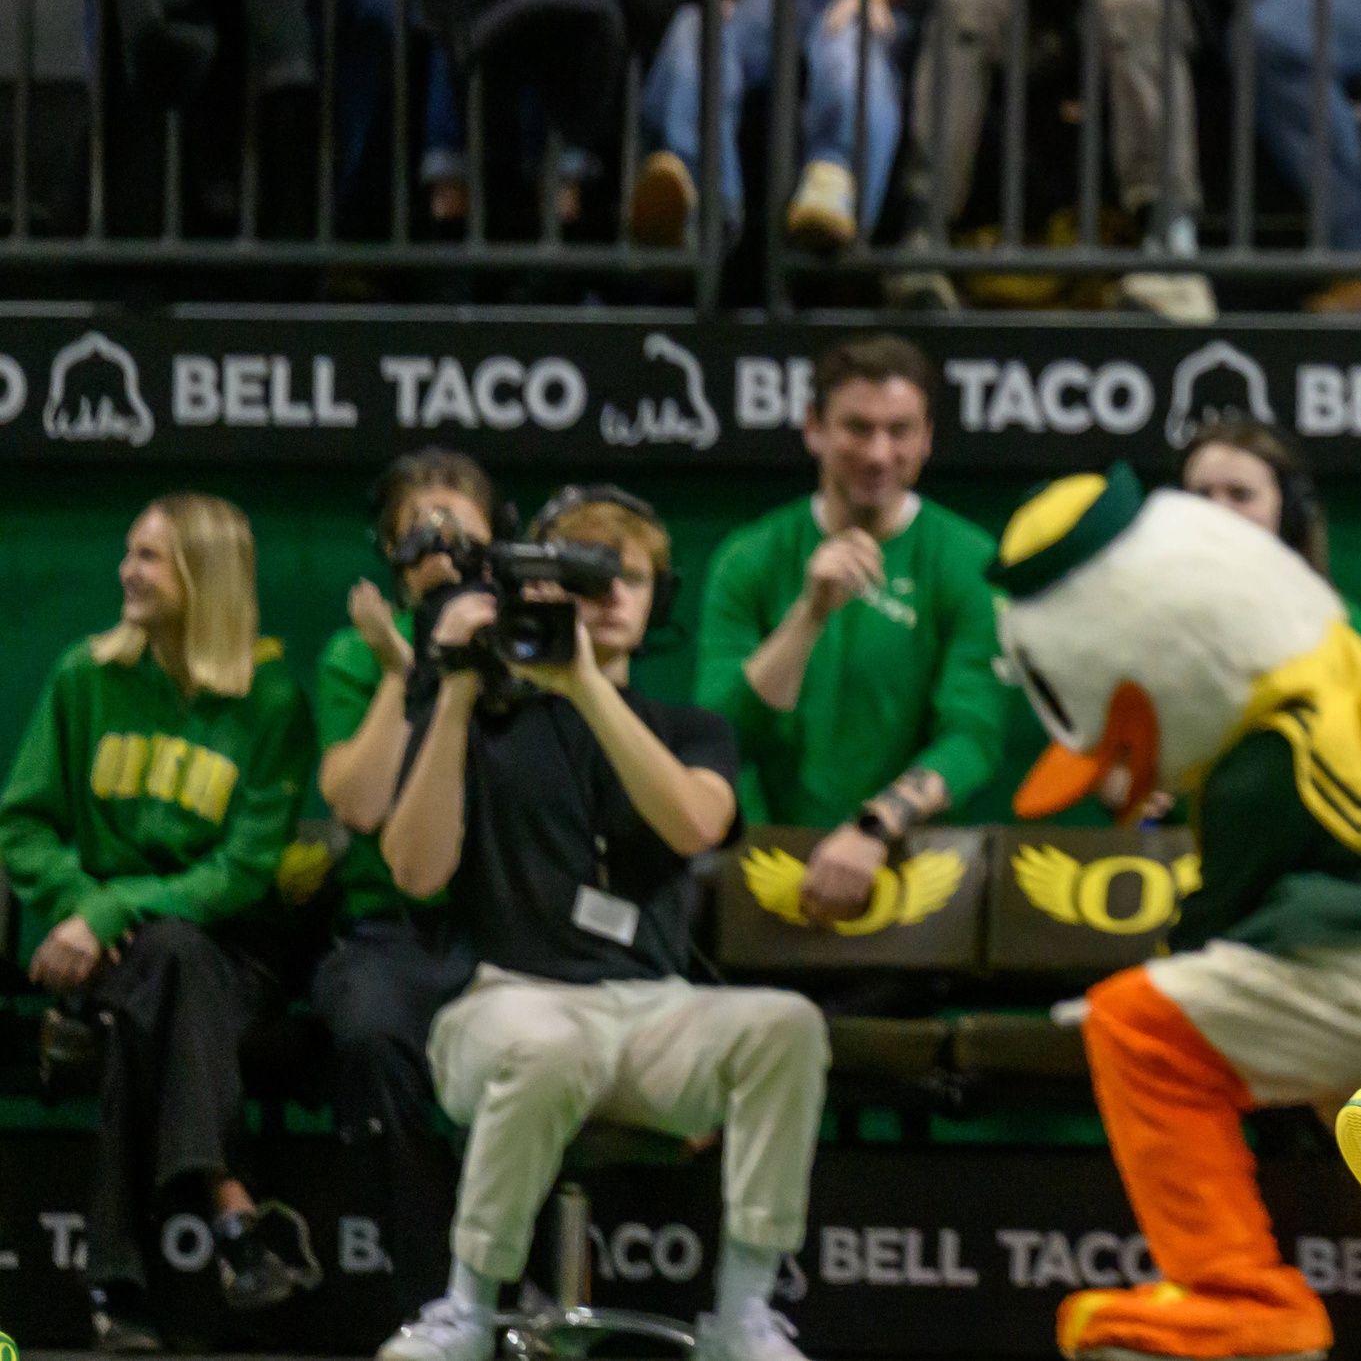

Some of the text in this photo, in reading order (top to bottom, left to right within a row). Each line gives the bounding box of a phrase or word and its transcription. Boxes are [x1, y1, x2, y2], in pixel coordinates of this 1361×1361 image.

[172, 354, 358, 429] BELL
[380, 356, 588, 431] TACO
[946, 360, 1154, 436] TACO
[819, 1226, 980, 1288] BELL
